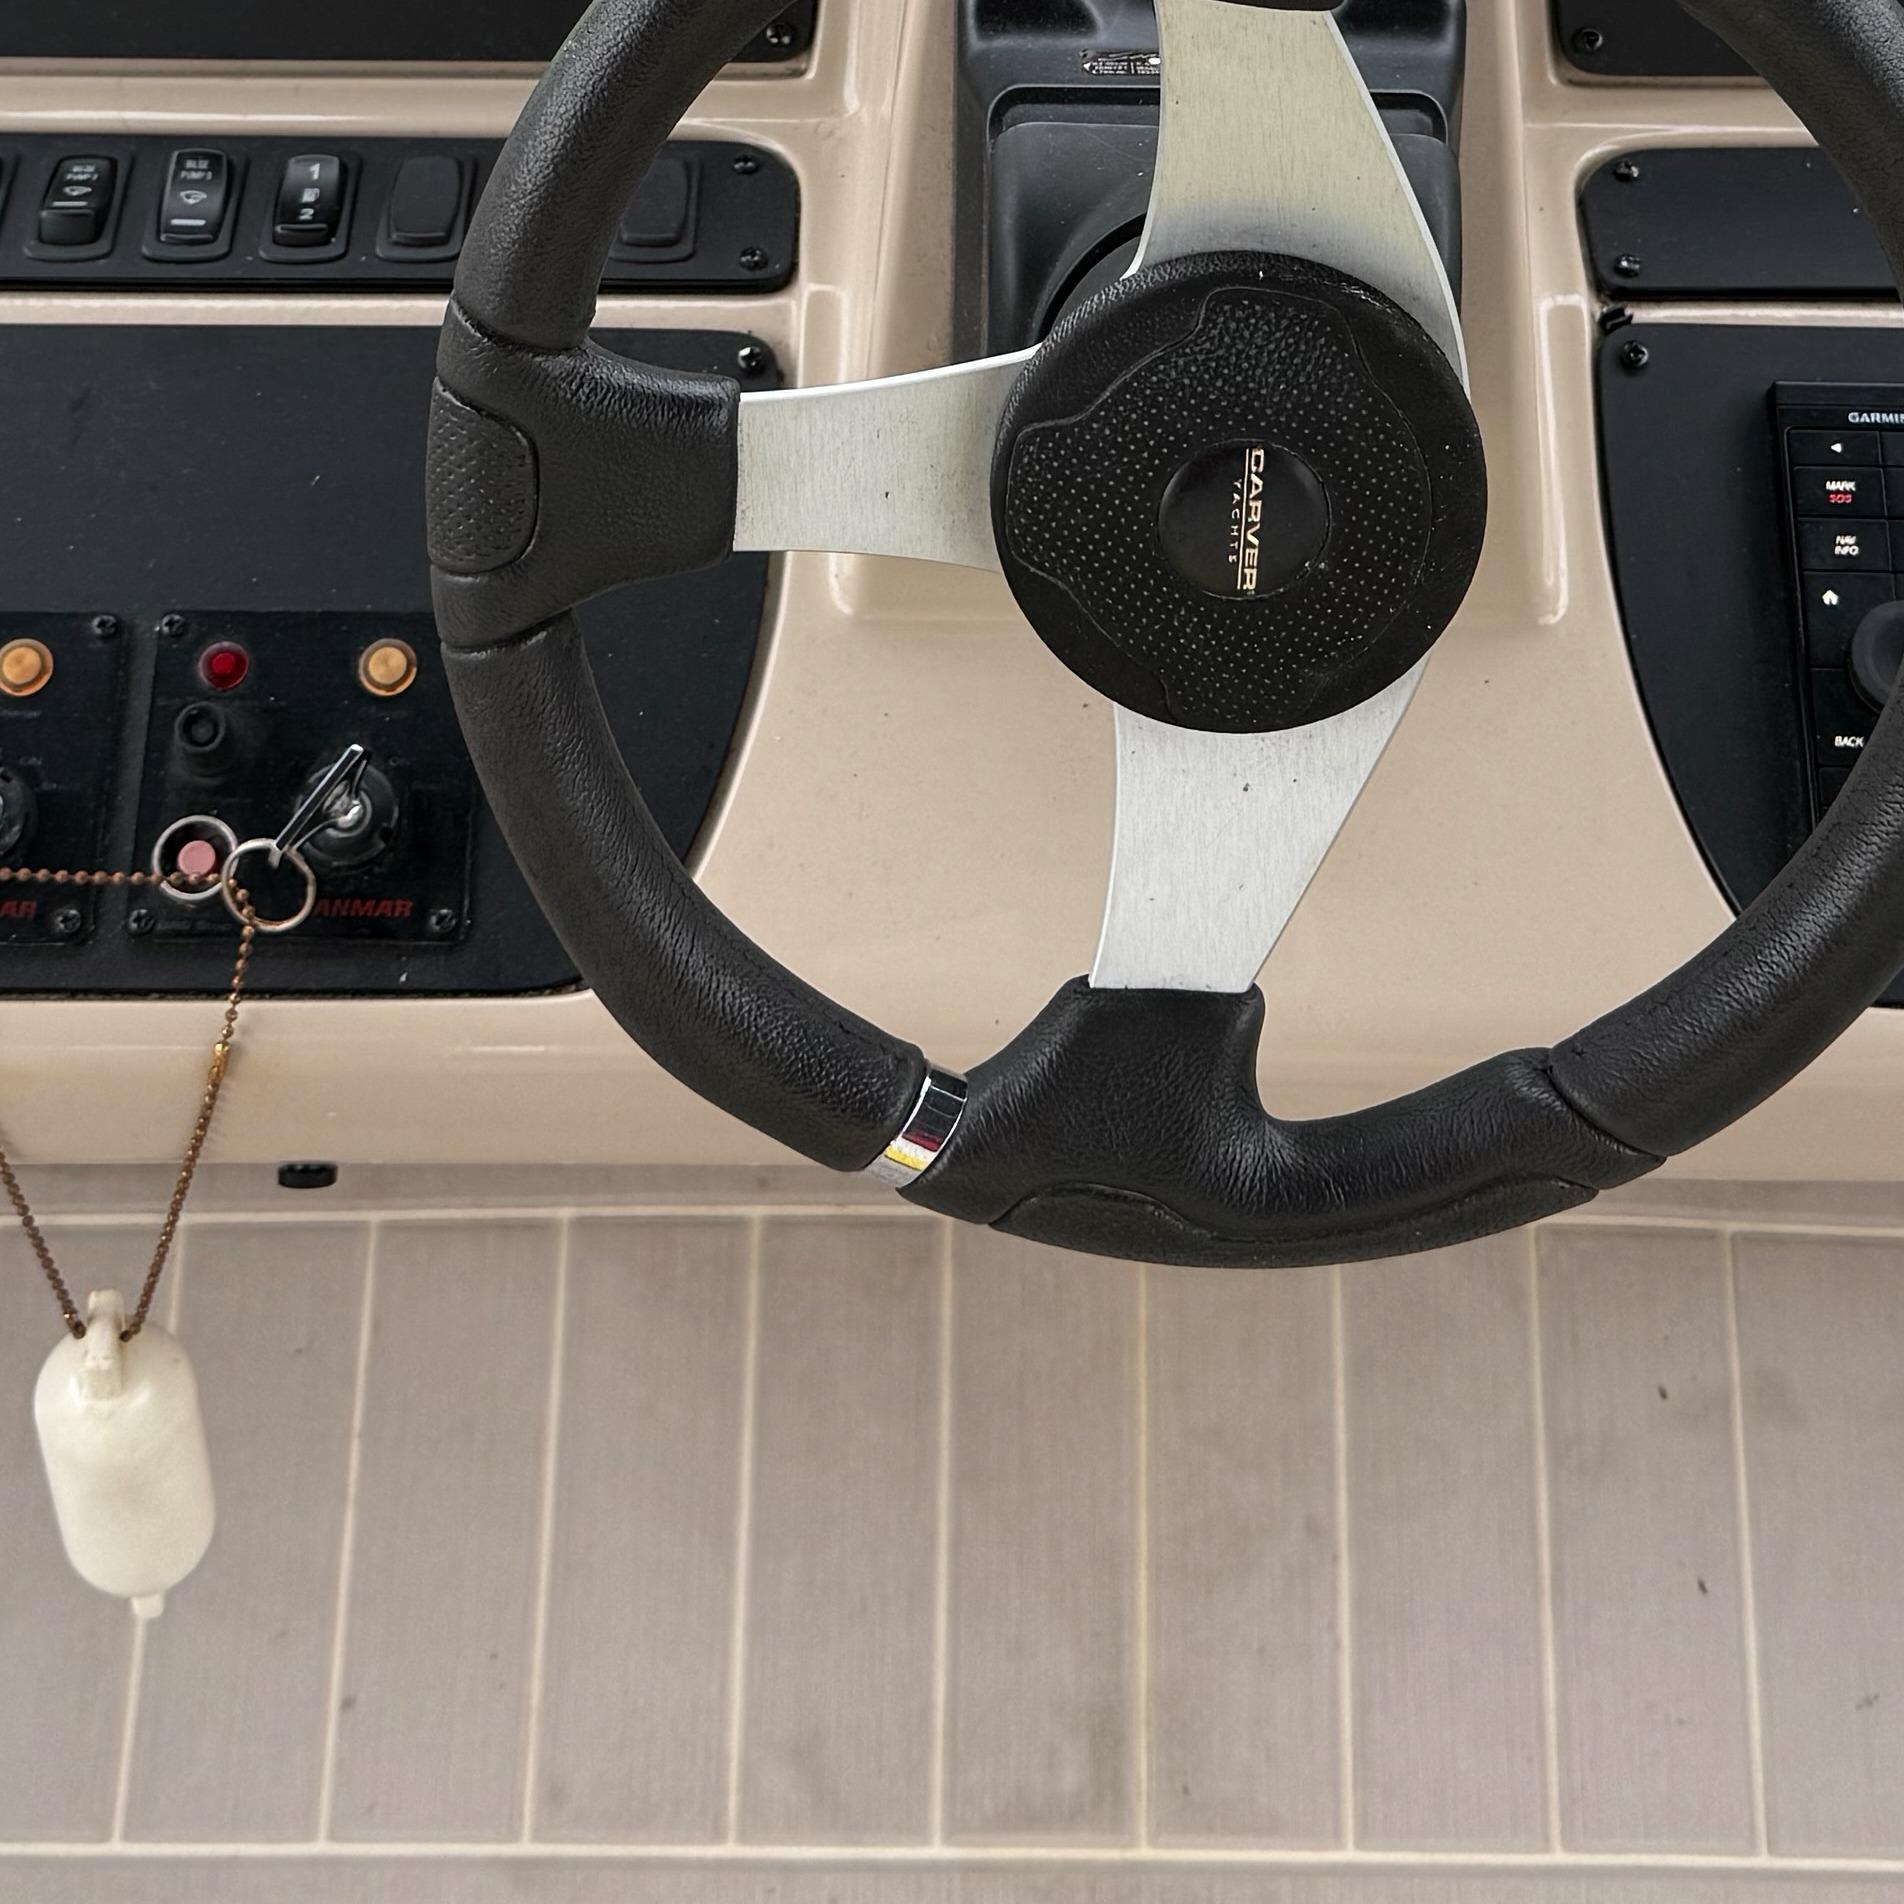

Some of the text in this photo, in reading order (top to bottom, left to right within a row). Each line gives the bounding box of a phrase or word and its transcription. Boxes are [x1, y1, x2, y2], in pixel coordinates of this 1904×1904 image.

[309, 163, 321, 180] 1
[299, 208, 315, 220] 2
[1826, 480, 1856, 491] MARK
[1829, 494, 1853, 503] SOS
[1229, 481, 1243, 565] YACHTS
[1242, 447, 1265, 594] CARVER
[1836, 535, 1857, 545] NAV
[1834, 546, 1859, 556] INFO
[1834, 735, 1864, 748] BACK
[312, 897, 414, 918] ANMAR
